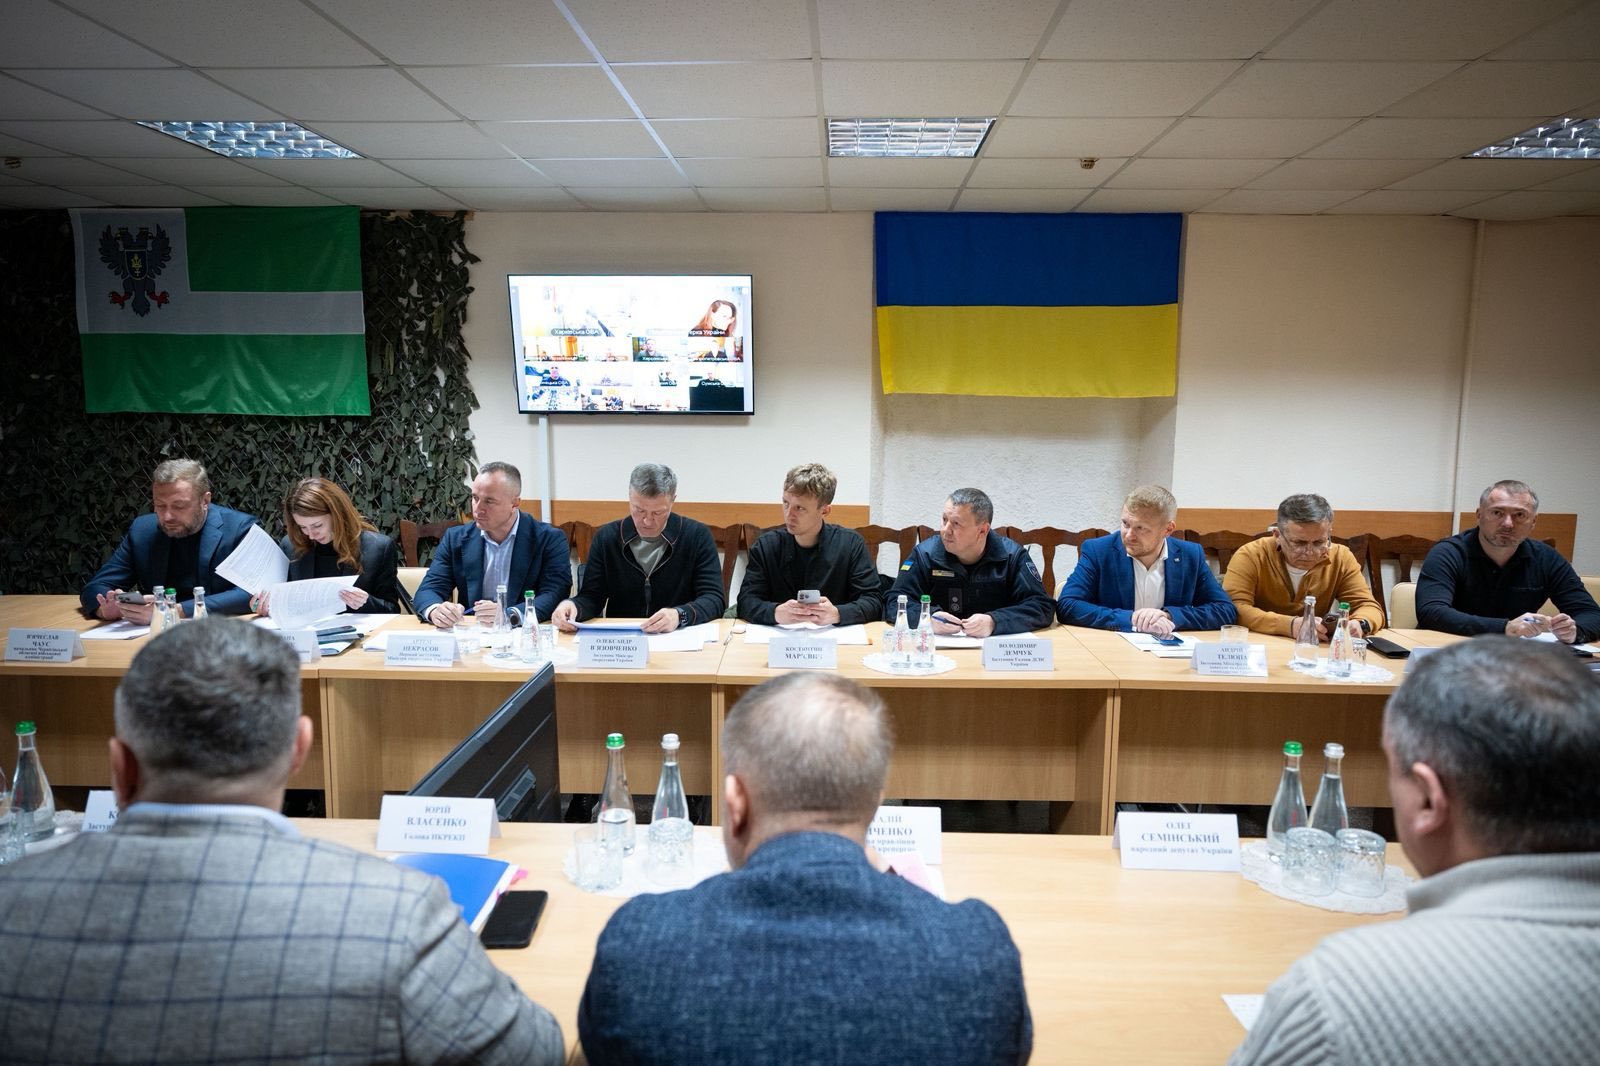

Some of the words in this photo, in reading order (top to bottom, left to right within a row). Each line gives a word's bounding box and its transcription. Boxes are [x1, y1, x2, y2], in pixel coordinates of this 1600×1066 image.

[424, 805, 452, 814] ЮРІЙ
[406, 816, 467, 828] ВЛАСЕНКО
[1165, 821, 1192, 830] ОЛЕГ
[404, 832, 430, 840] Голова
[1141, 832, 1220, 843] СЕМІНСЬКИЙ
[1130, 846, 1168, 854] народний
[1200, 847, 1233, 855] України
